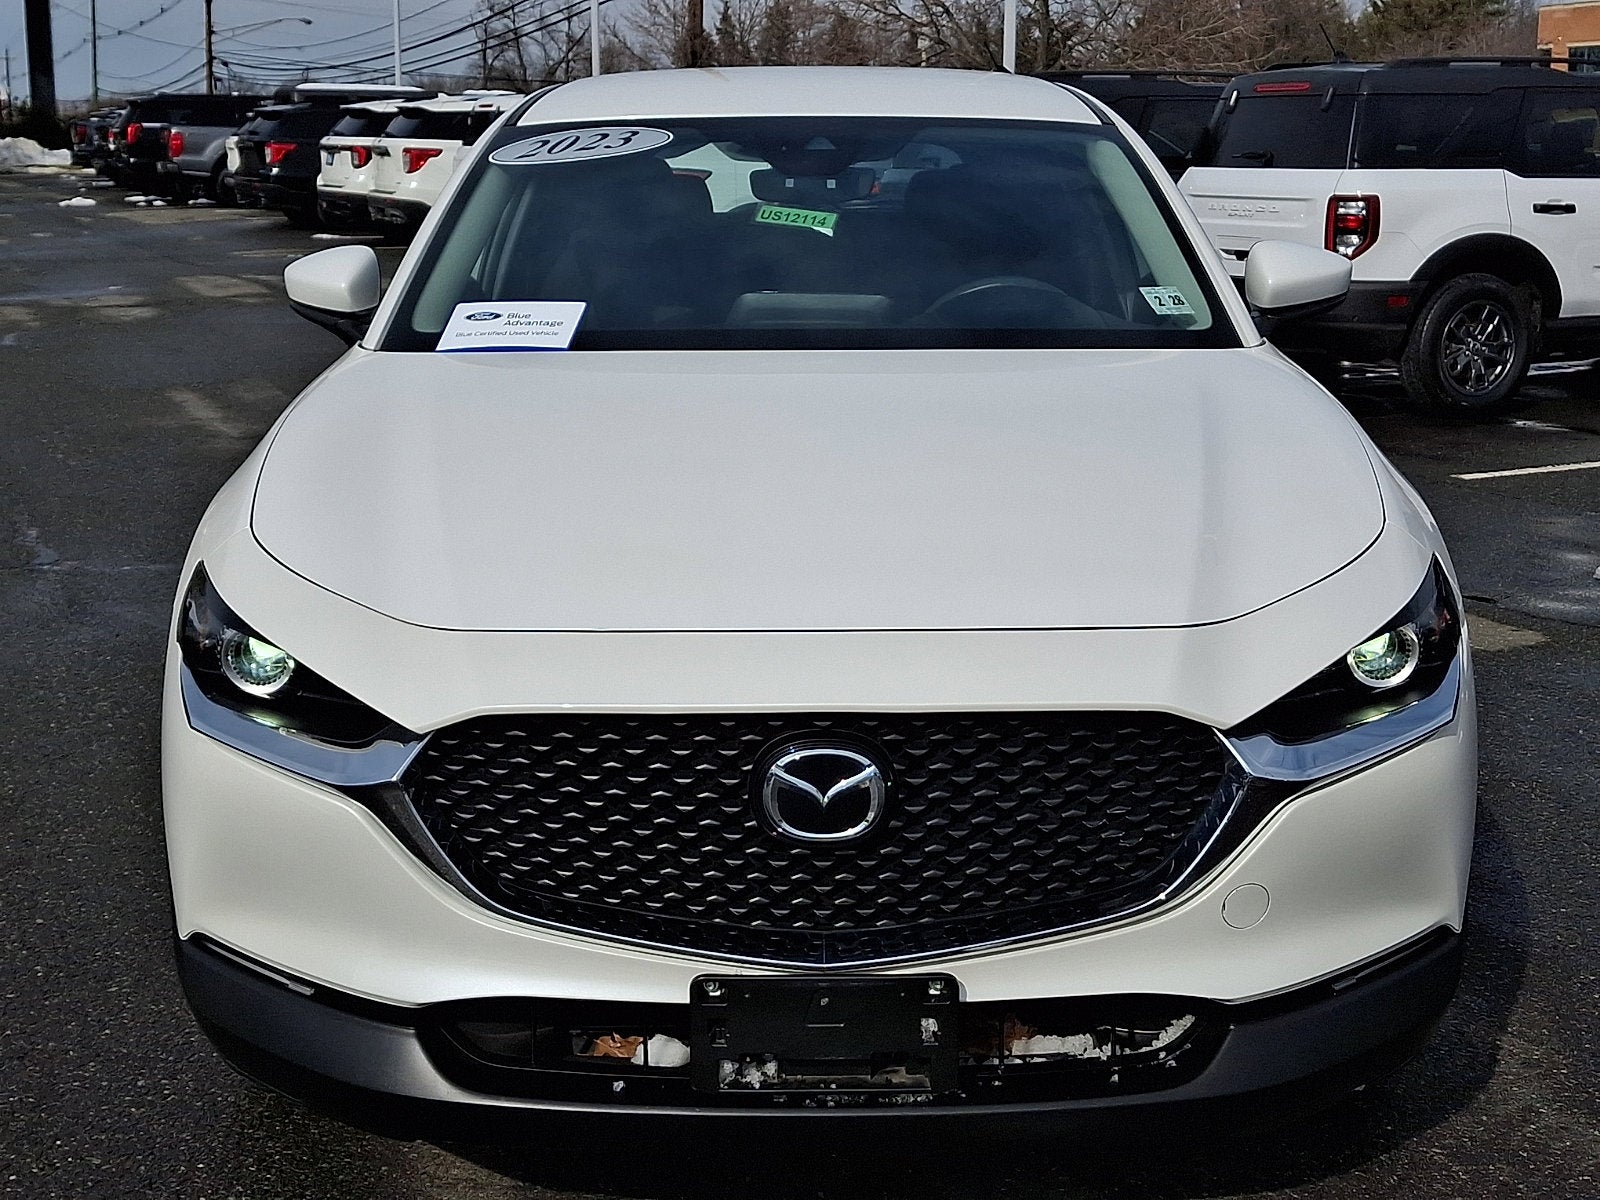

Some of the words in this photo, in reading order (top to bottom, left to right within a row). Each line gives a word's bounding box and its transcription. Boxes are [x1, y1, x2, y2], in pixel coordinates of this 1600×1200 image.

[513, 130, 640, 160] 2023
[760, 209, 827, 227] US12114
[1153, 295, 1167, 307] 2
[1168, 294, 1186, 306] 28
[506, 312, 532, 320] Blue
[502, 319, 564, 328] Advantage
